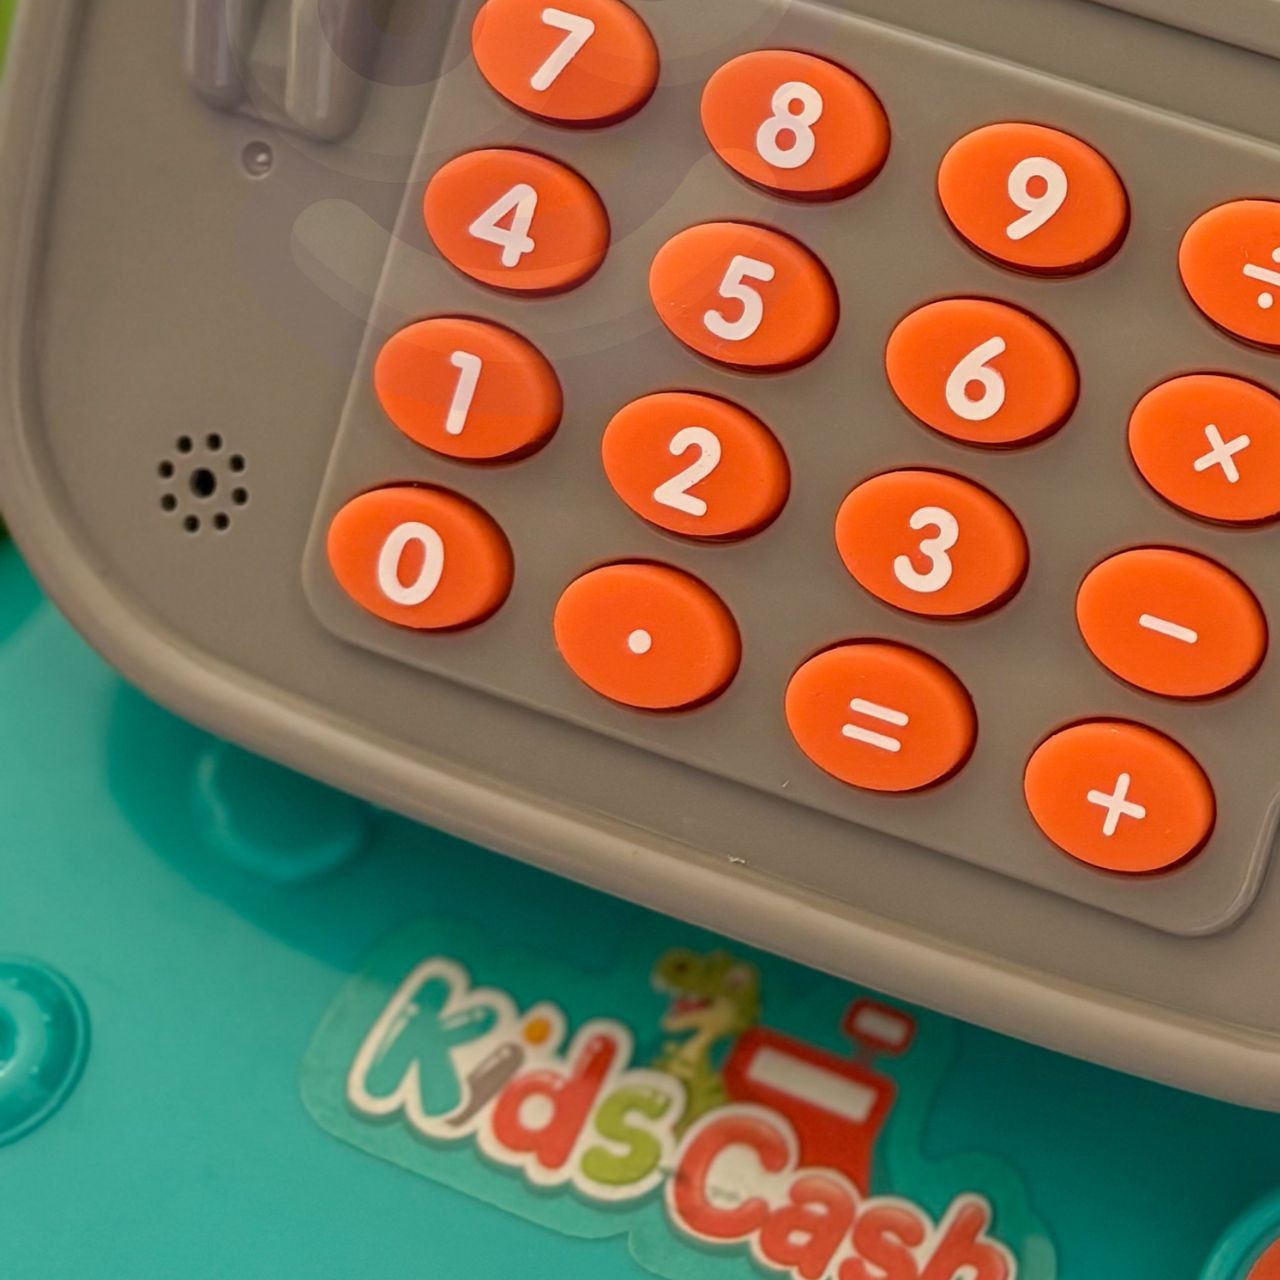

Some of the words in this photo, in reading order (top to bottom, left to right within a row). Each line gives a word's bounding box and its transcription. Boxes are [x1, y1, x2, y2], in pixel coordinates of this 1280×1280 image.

[529, 7, 596, 92] 7
[754, 80, 824, 170] 8
[467, 182, 538, 268] 4
[1006, 156, 1069, 241] 9
[702, 254, 776, 342] 5
[444, 350, 483, 436] 1
[944, 335, 1007, 422] 6
[652, 426, 722, 517] 2
[376, 521, 445, 606] 0
[892, 506, 960, 594] 3
